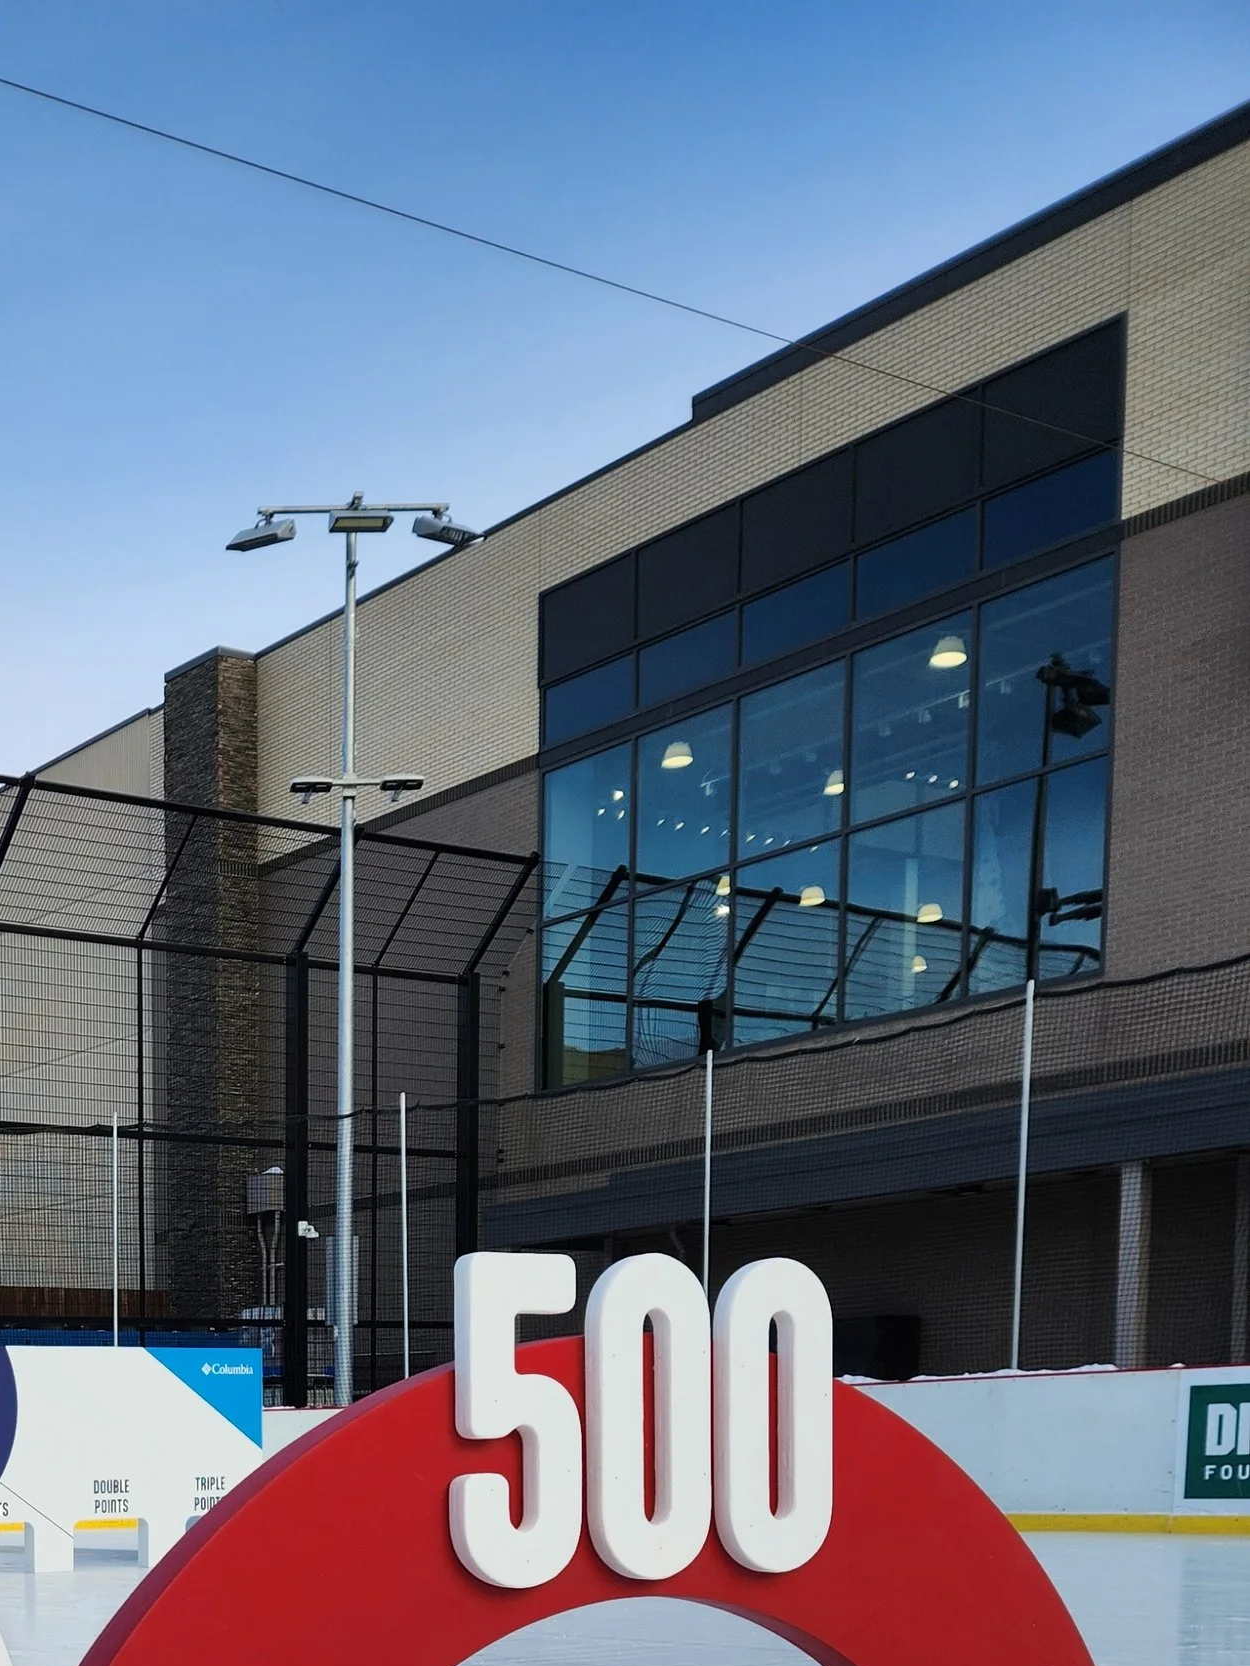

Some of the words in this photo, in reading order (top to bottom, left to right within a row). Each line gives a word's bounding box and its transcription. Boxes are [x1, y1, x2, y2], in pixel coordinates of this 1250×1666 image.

[211, 1363, 254, 1375] Columbia
[450, 1251, 833, 1589] 500
[93, 1479, 130, 1494] DOUBLE
[195, 1476, 225, 1491] TRIPLE
[94, 1498, 129, 1514] POINTS
[194, 1496, 221, 1511] POIN
